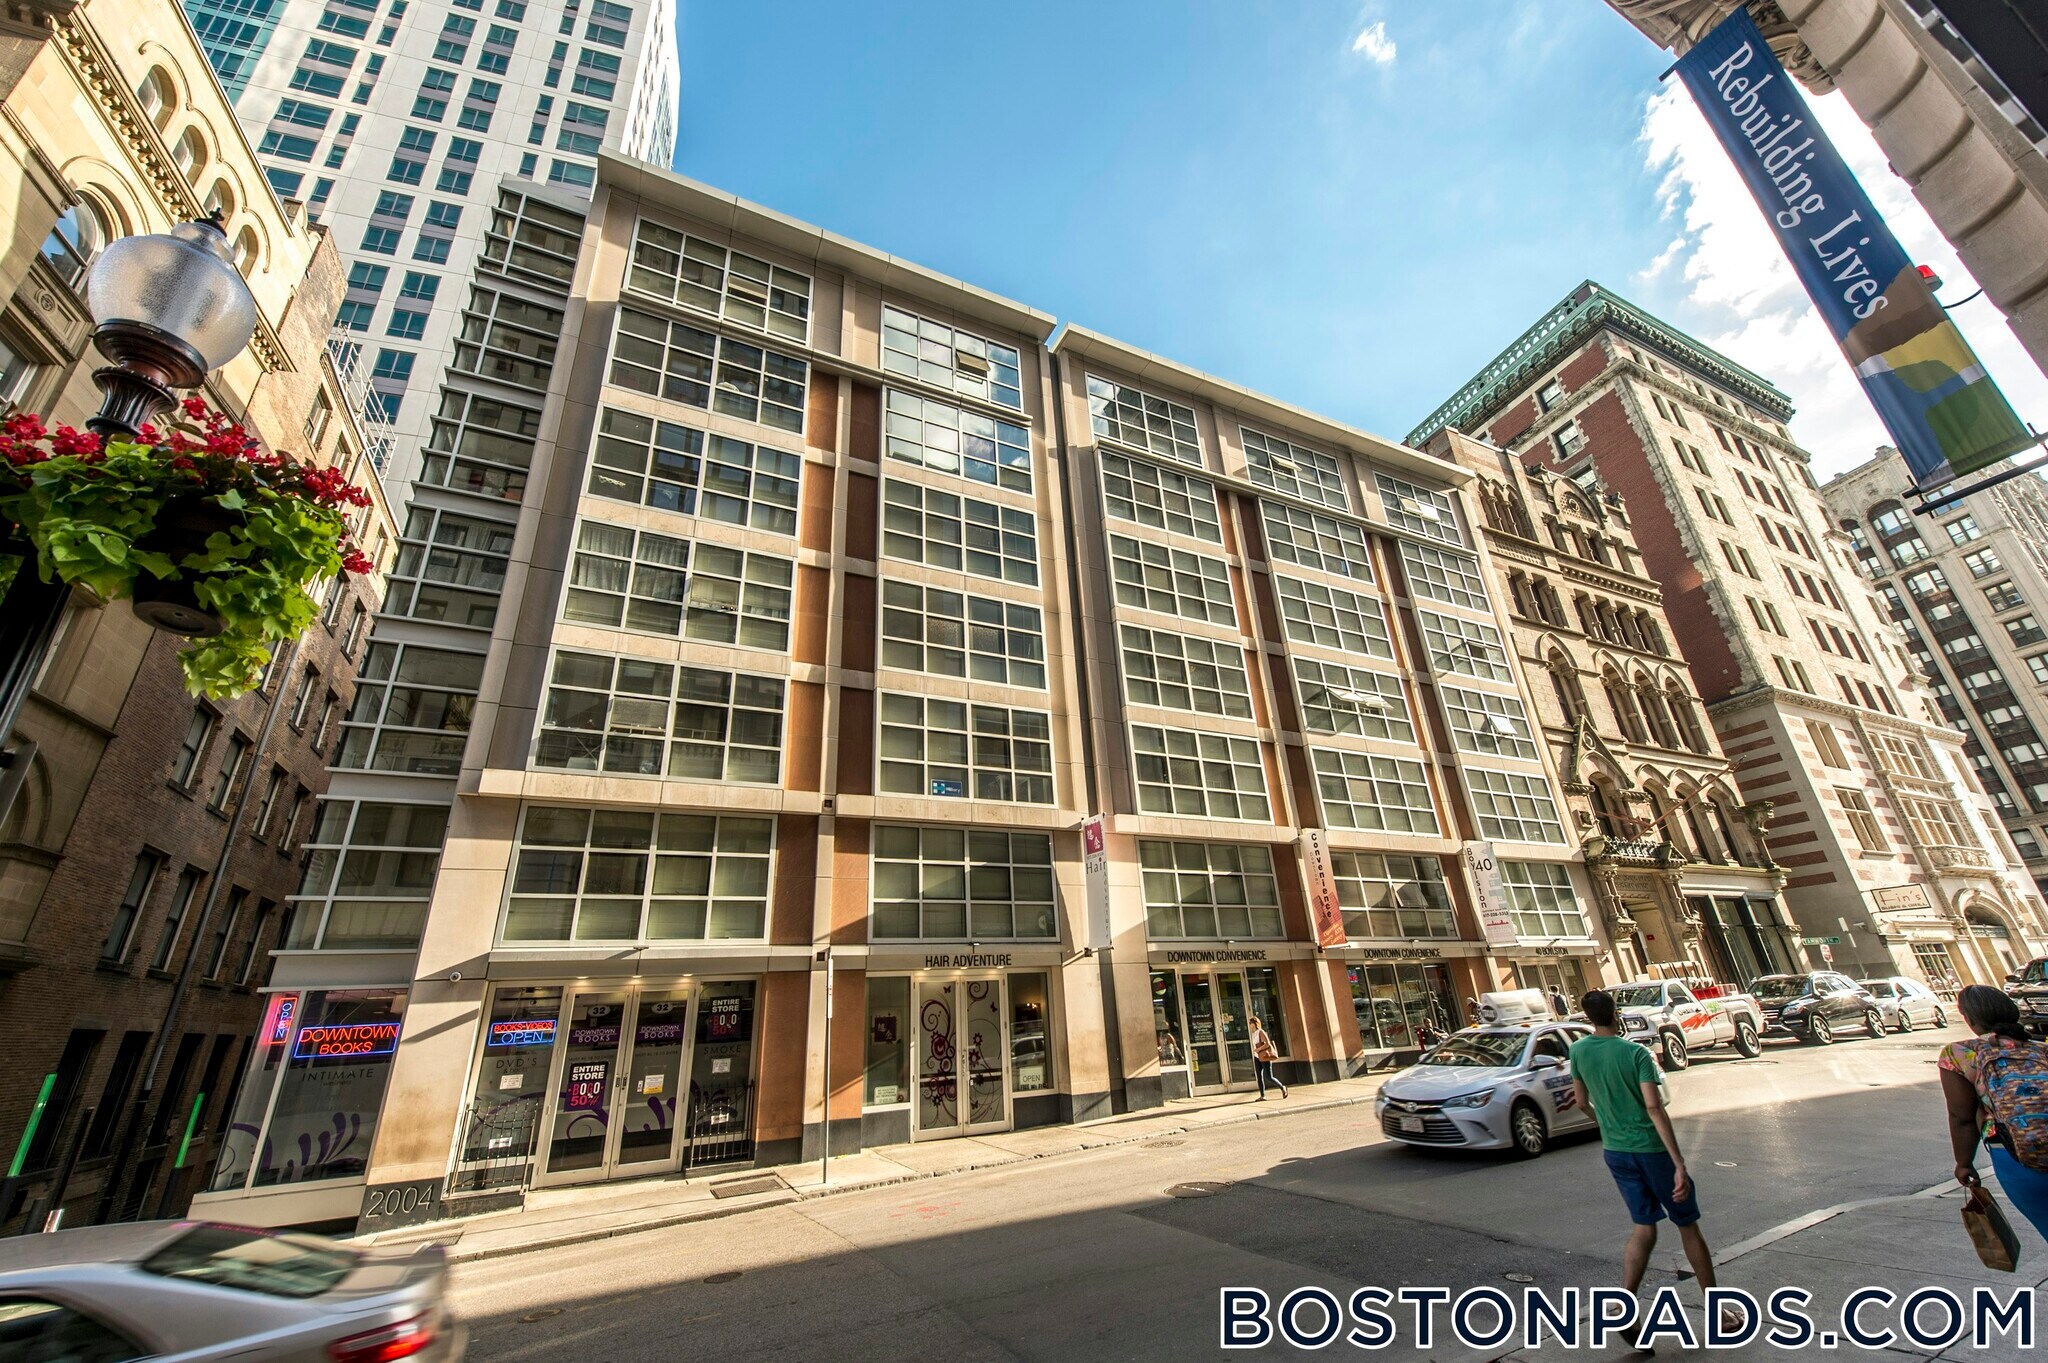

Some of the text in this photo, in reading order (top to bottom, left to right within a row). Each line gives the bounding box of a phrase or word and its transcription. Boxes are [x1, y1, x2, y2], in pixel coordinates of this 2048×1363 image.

[1709, 41, 1889, 319] Rebuilding Lives
[1086, 857, 1107, 874] Hair
[1475, 858, 1492, 872] 40
[1311, 833, 1332, 918] Convenience
[1466, 847, 1487, 909] Boylston
[1879, 889, 1921, 905] Fin's
[1167, 950, 1267, 962] DOWNTOWN CONVENIENCE
[1364, 948, 1441, 958] DOWNTOWN CONVENIENCE
[925, 954, 1012, 967] HAIR ADVENTURE
[592, 1007, 606, 1015] 32
[656, 1003, 669, 1011] 32
[275, 1003, 292, 1038] OPEN
[300, 1026, 399, 1042] DOWNTOWN
[641, 1025, 680, 1033] DOWNTOWN
[644, 1031, 674, 1039] BOOKS
[501, 1031, 544, 1044] OPEN
[579, 1035, 610, 1043] BOOKS
[319, 1041, 373, 1055] BOOKS
[704, 1045, 741, 1055] SMOKE
[496, 1058, 537, 1068] DVD'S
[573, 1064, 605, 1073] ENTIRE
[302, 1068, 375, 1082] INTIMATE
[572, 1072, 604, 1081] STORE
[572, 1081, 601, 1095] BOGO
[365, 1184, 434, 1218] 2004
